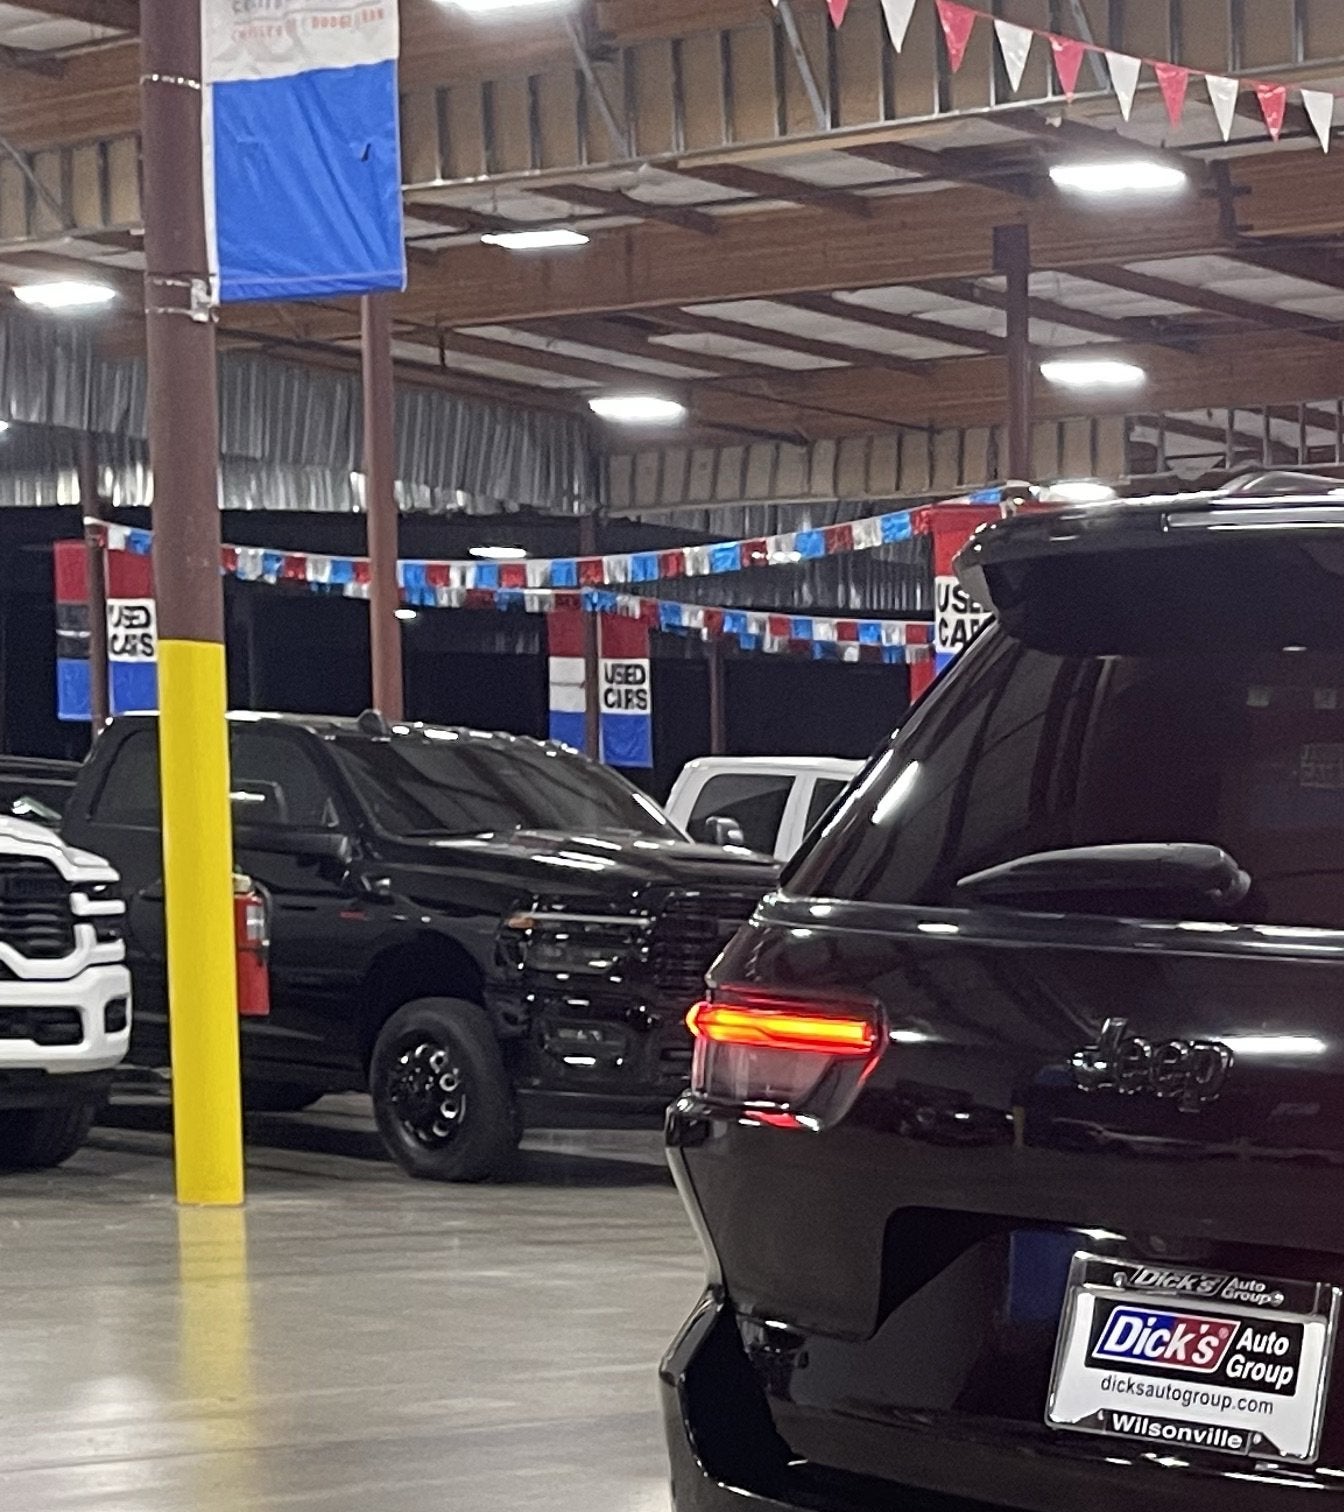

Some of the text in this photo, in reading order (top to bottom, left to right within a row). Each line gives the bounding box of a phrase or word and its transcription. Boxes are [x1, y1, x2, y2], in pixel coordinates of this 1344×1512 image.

[937, 583, 991, 614] US
[938, 616, 979, 648] CA
[1133, 1267, 1221, 1293] Dick's
[1225, 1277, 1267, 1293] Auto
[1220, 1286, 1273, 1306] Group
[1102, 1314, 1220, 1366] Dick's
[1236, 1327, 1290, 1356] Auto
[1225, 1353, 1295, 1391] Group
[1099, 1374, 1275, 1415] dicksautogroup.com
[1111, 1411, 1244, 1450] Wilsonville
